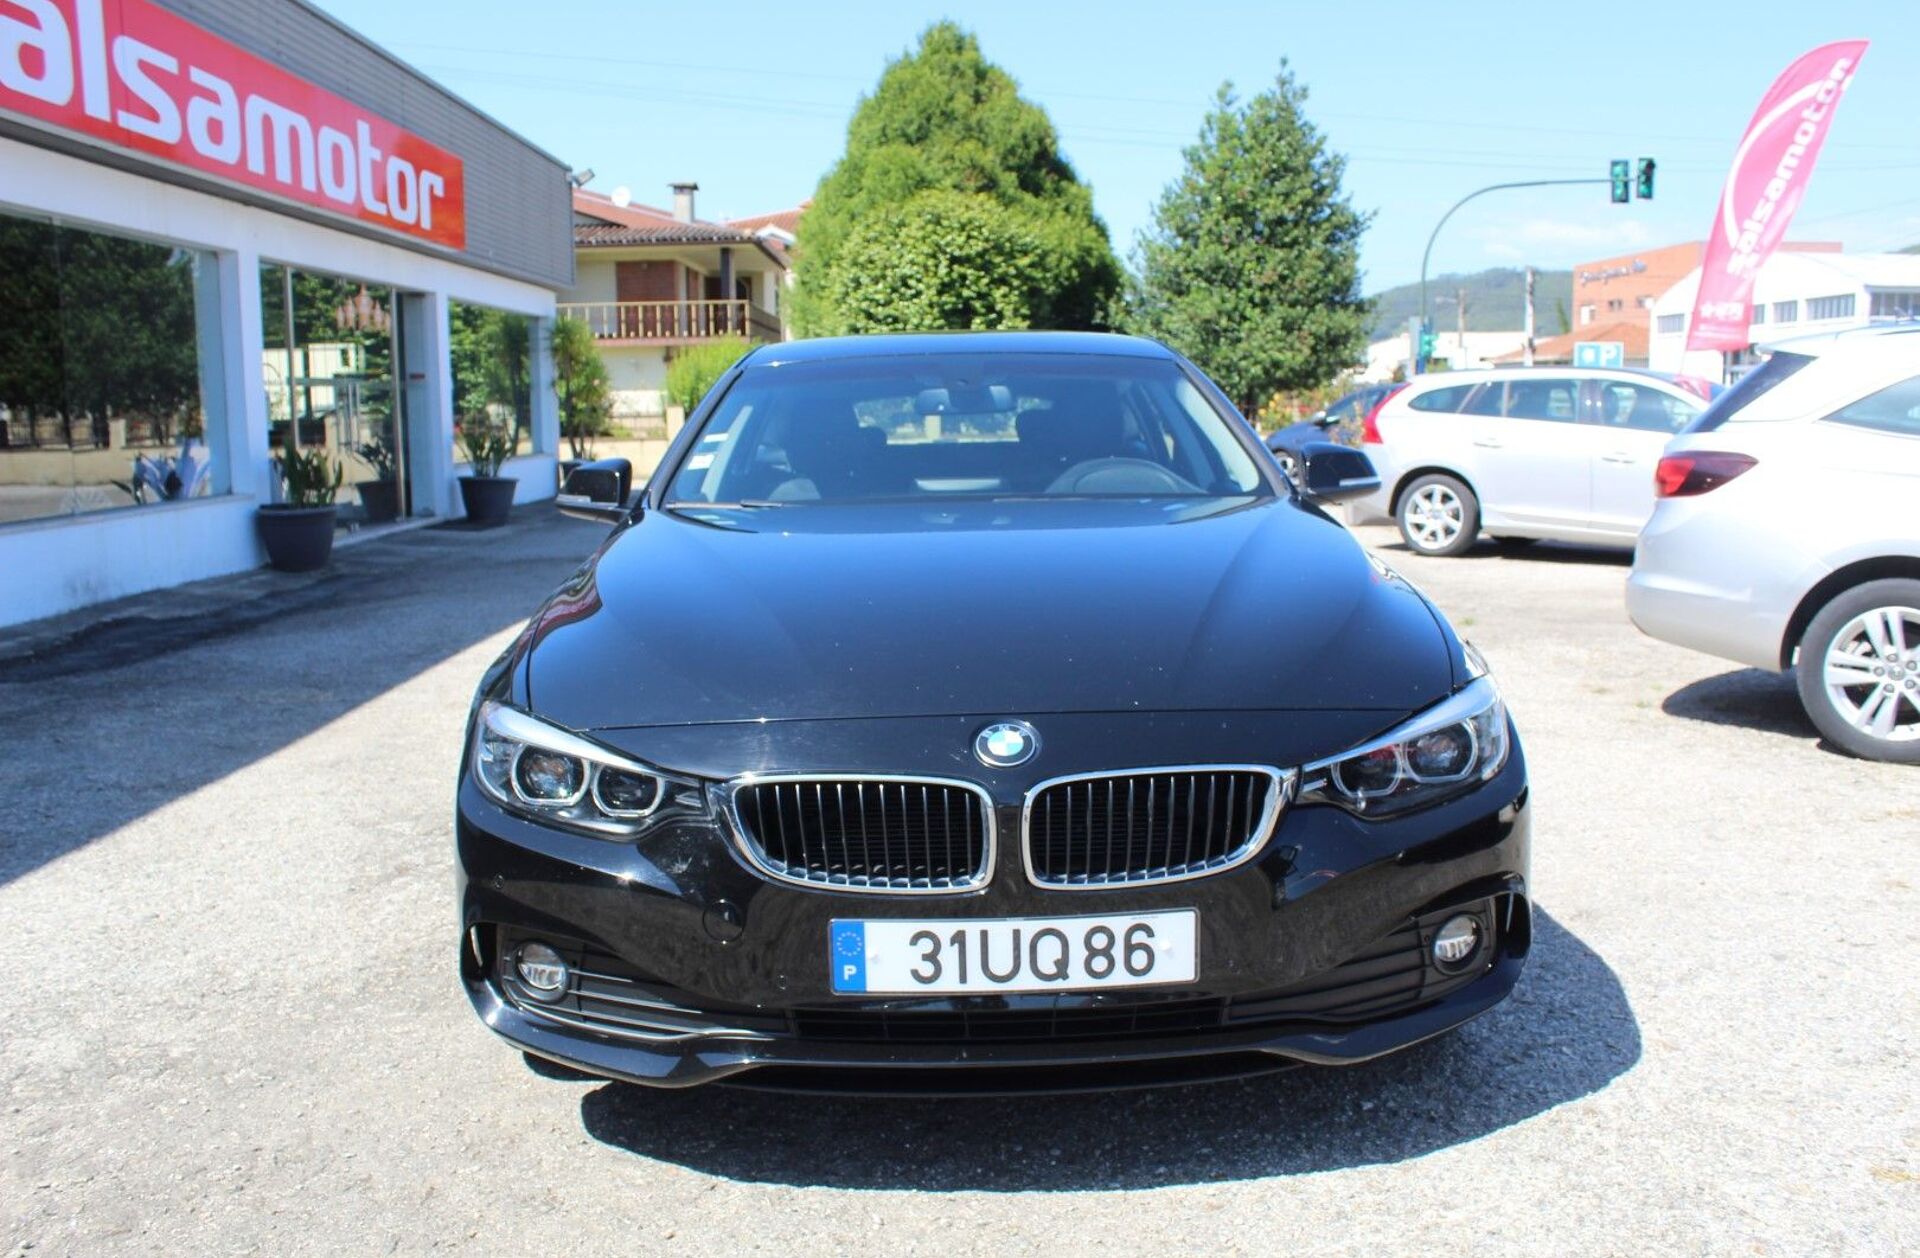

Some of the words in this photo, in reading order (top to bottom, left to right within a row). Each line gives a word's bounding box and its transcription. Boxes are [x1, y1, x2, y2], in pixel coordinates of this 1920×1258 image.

[0, 0, 444, 231] alsamotor
[843, 964, 857, 981] P
[909, 922, 1156, 985] 31UQ86
